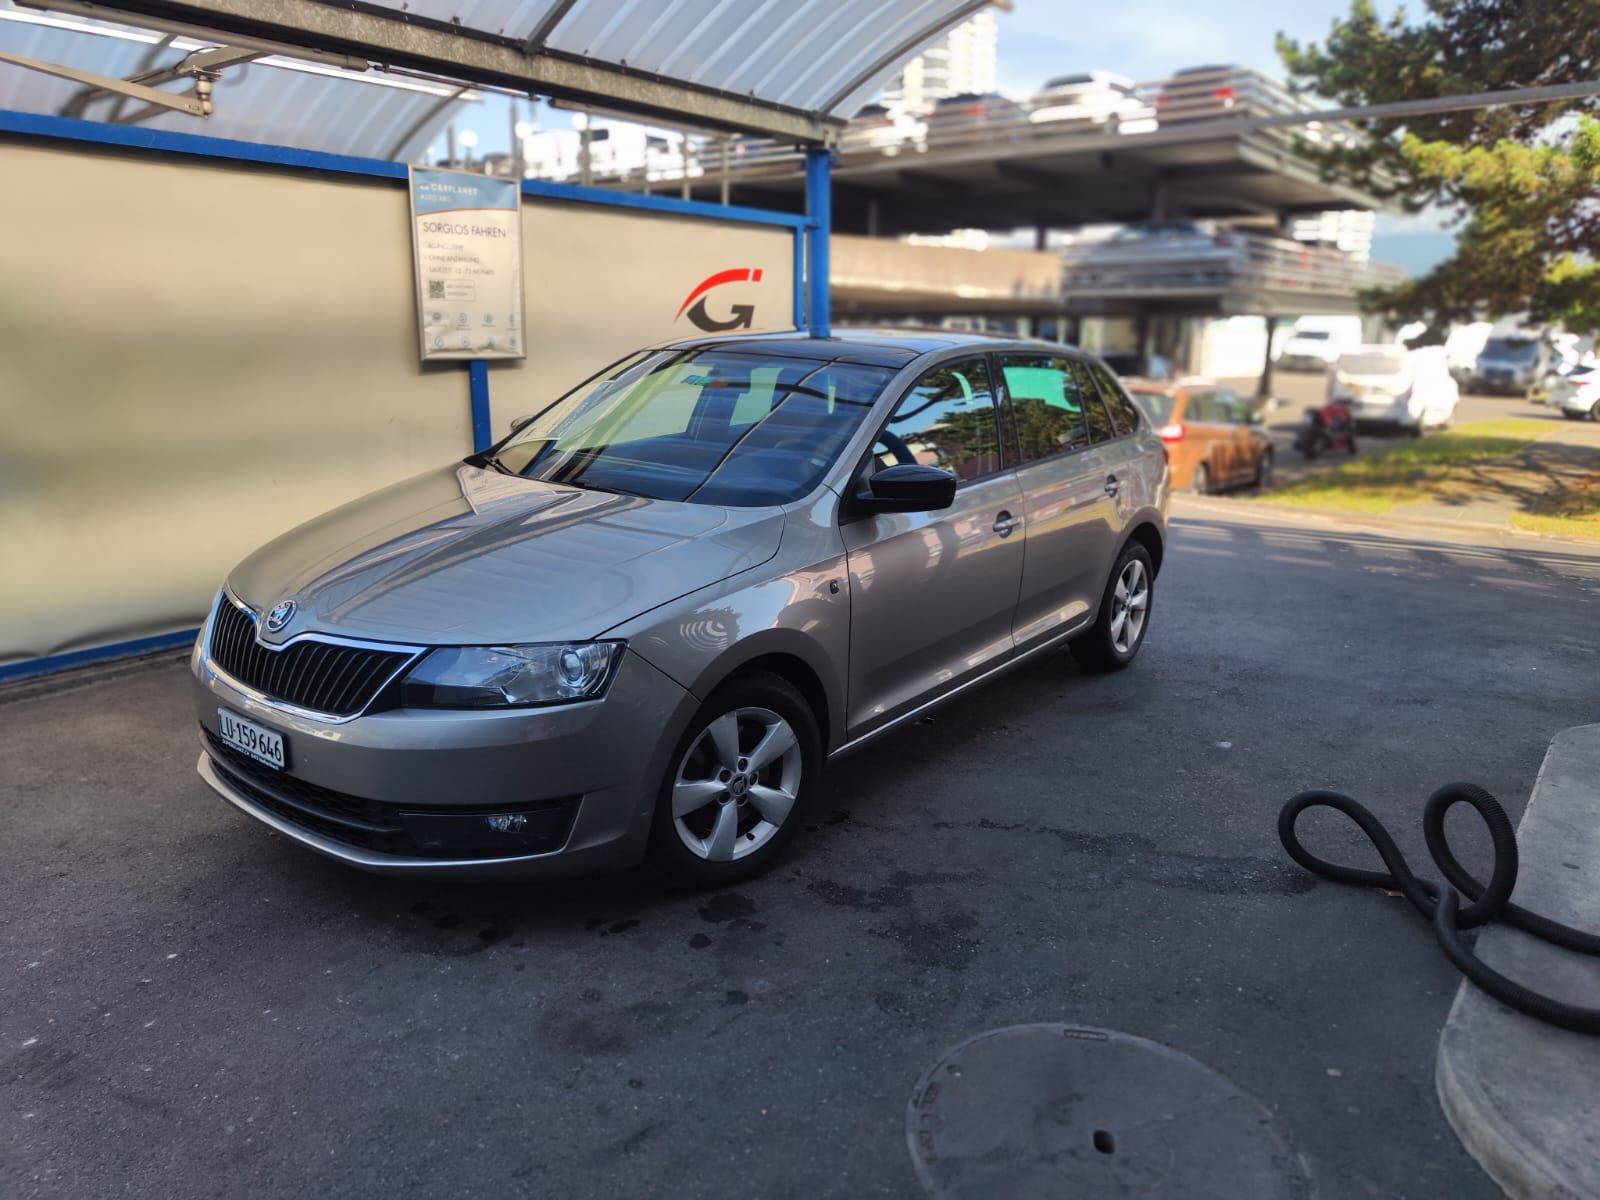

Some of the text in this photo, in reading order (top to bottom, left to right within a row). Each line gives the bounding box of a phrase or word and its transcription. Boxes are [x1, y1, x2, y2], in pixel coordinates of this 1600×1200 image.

[423, 221, 506, 238] SORGLOS FAHREN
[259, 733, 282, 762] 646
